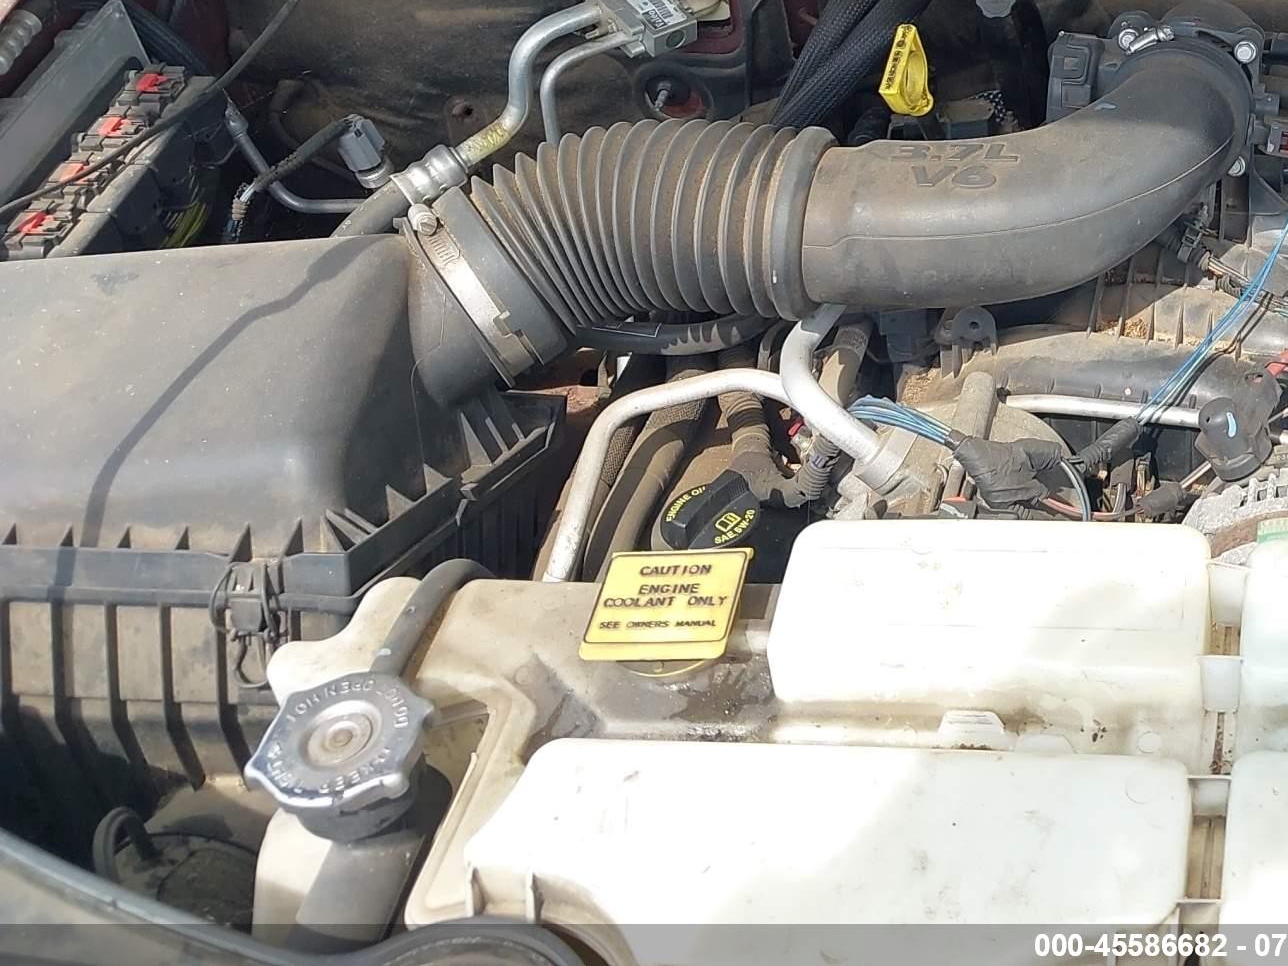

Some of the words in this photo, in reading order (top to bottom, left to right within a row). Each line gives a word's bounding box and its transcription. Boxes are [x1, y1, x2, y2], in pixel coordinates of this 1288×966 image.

[890, 142, 1020, 163] 3.7L
[910, 164, 998, 189] V6
[666, 493, 692, 522] ENGINE
[714, 530, 735, 544] SAE
[639, 564, 712, 576] CAUTION
[638, 583, 700, 595] ENGINE
[603, 595, 677, 608] COOLANT
[687, 595, 728, 607] ONLY
[599, 620, 621, 629] SEE
[626, 619, 669, 629] OWNERS
[675, 619, 716, 628] MANUAL
